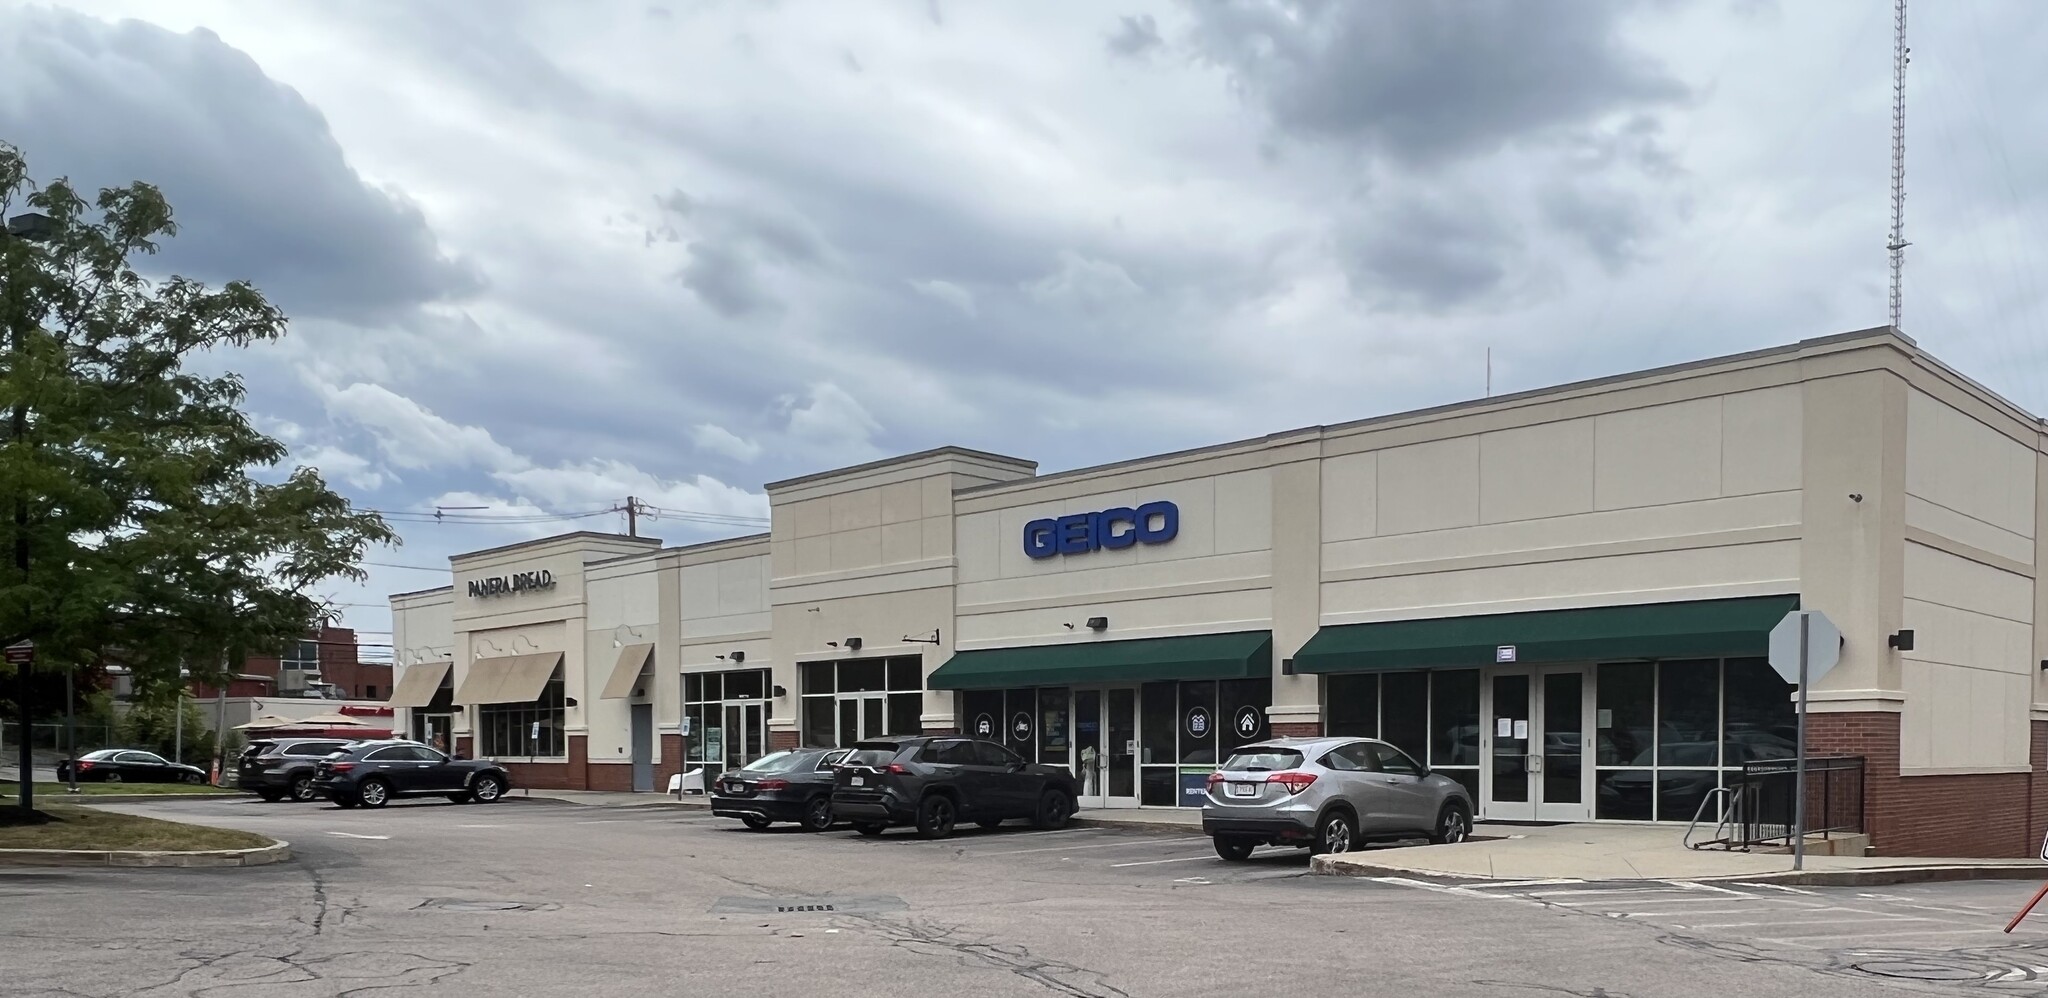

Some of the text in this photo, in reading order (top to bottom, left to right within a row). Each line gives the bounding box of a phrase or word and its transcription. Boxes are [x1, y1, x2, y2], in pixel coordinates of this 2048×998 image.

[1023, 500, 1179, 559] GEICO
[468, 569, 551, 597] PANERA BREAD
